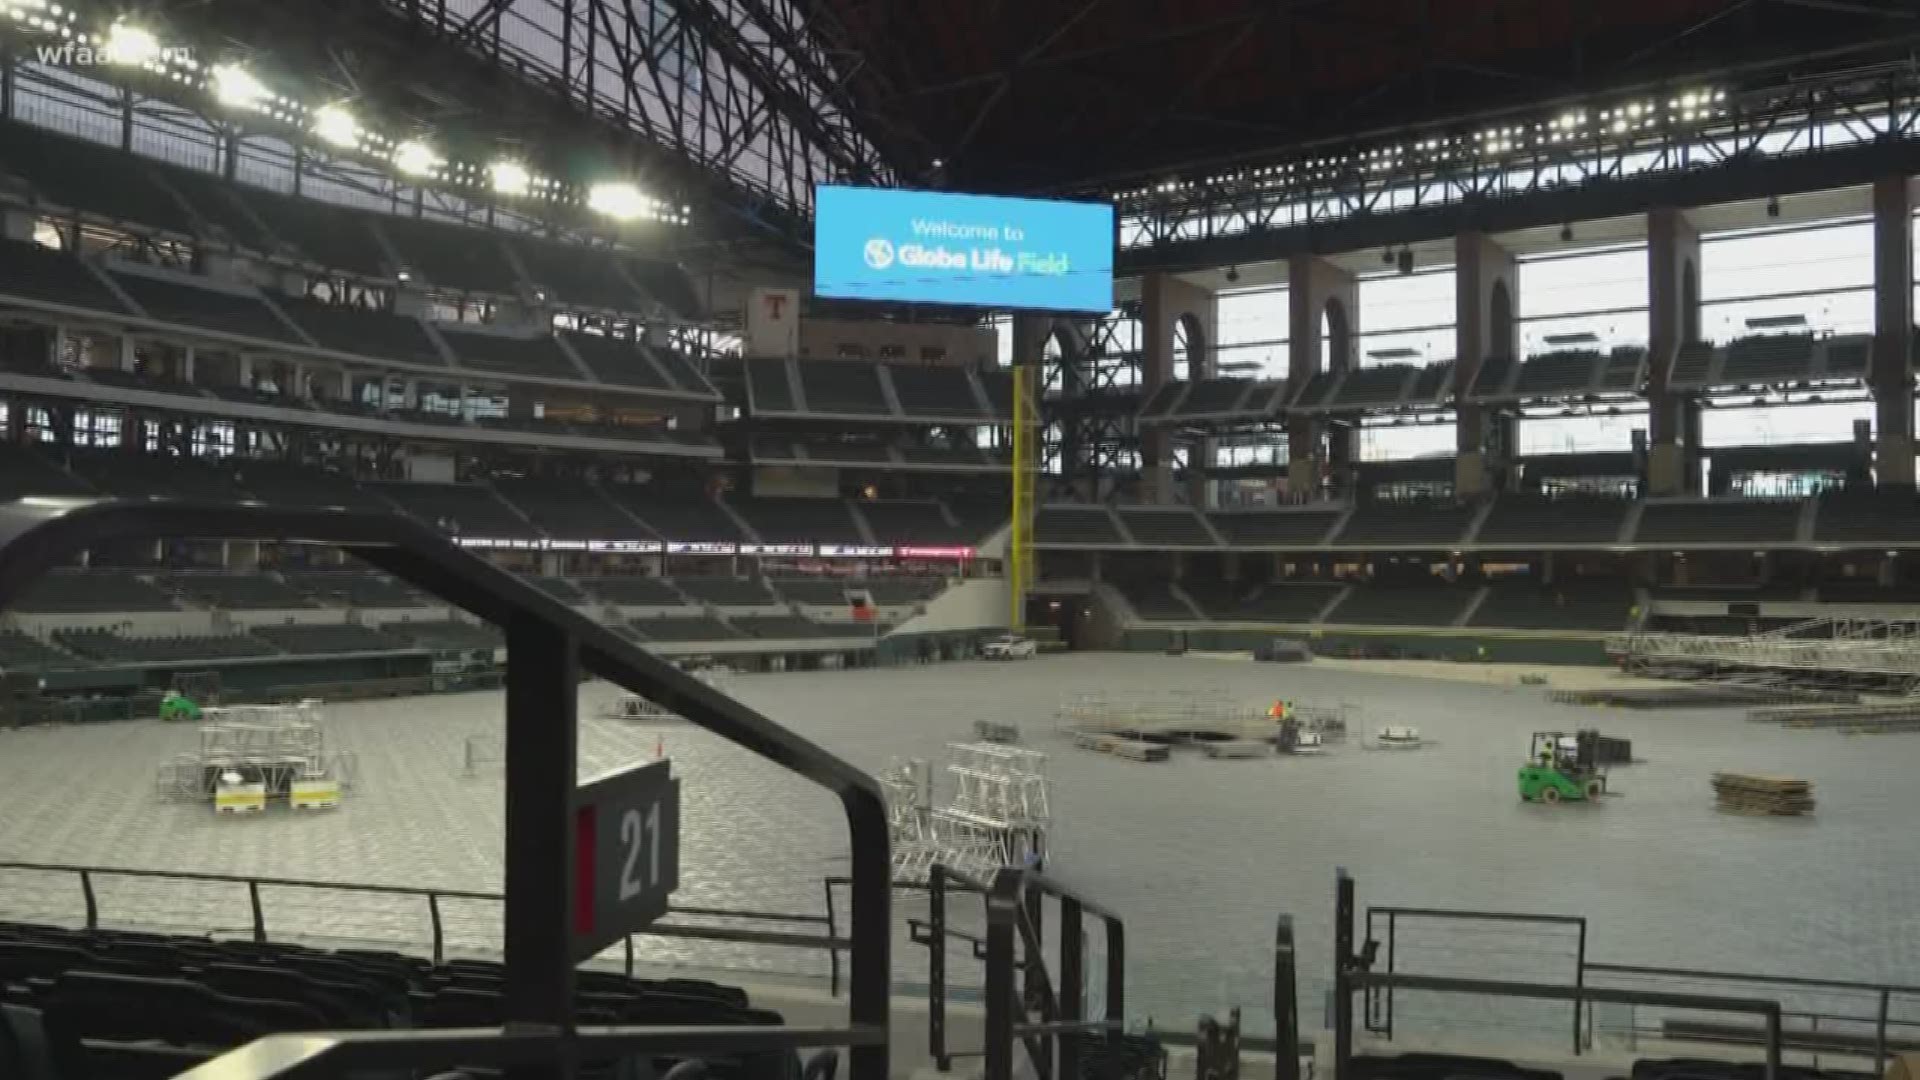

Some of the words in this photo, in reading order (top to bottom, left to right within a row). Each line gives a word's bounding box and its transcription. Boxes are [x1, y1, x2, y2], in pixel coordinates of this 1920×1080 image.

[911, 217, 998, 240] Welcome
[1004, 223, 1024, 241] to
[899, 243, 967, 269] Globe
[971, 247, 1014, 272] Life
[1017, 250, 1070, 276] Field
[764, 294, 787, 320] T
[619, 802, 661, 901] 21
